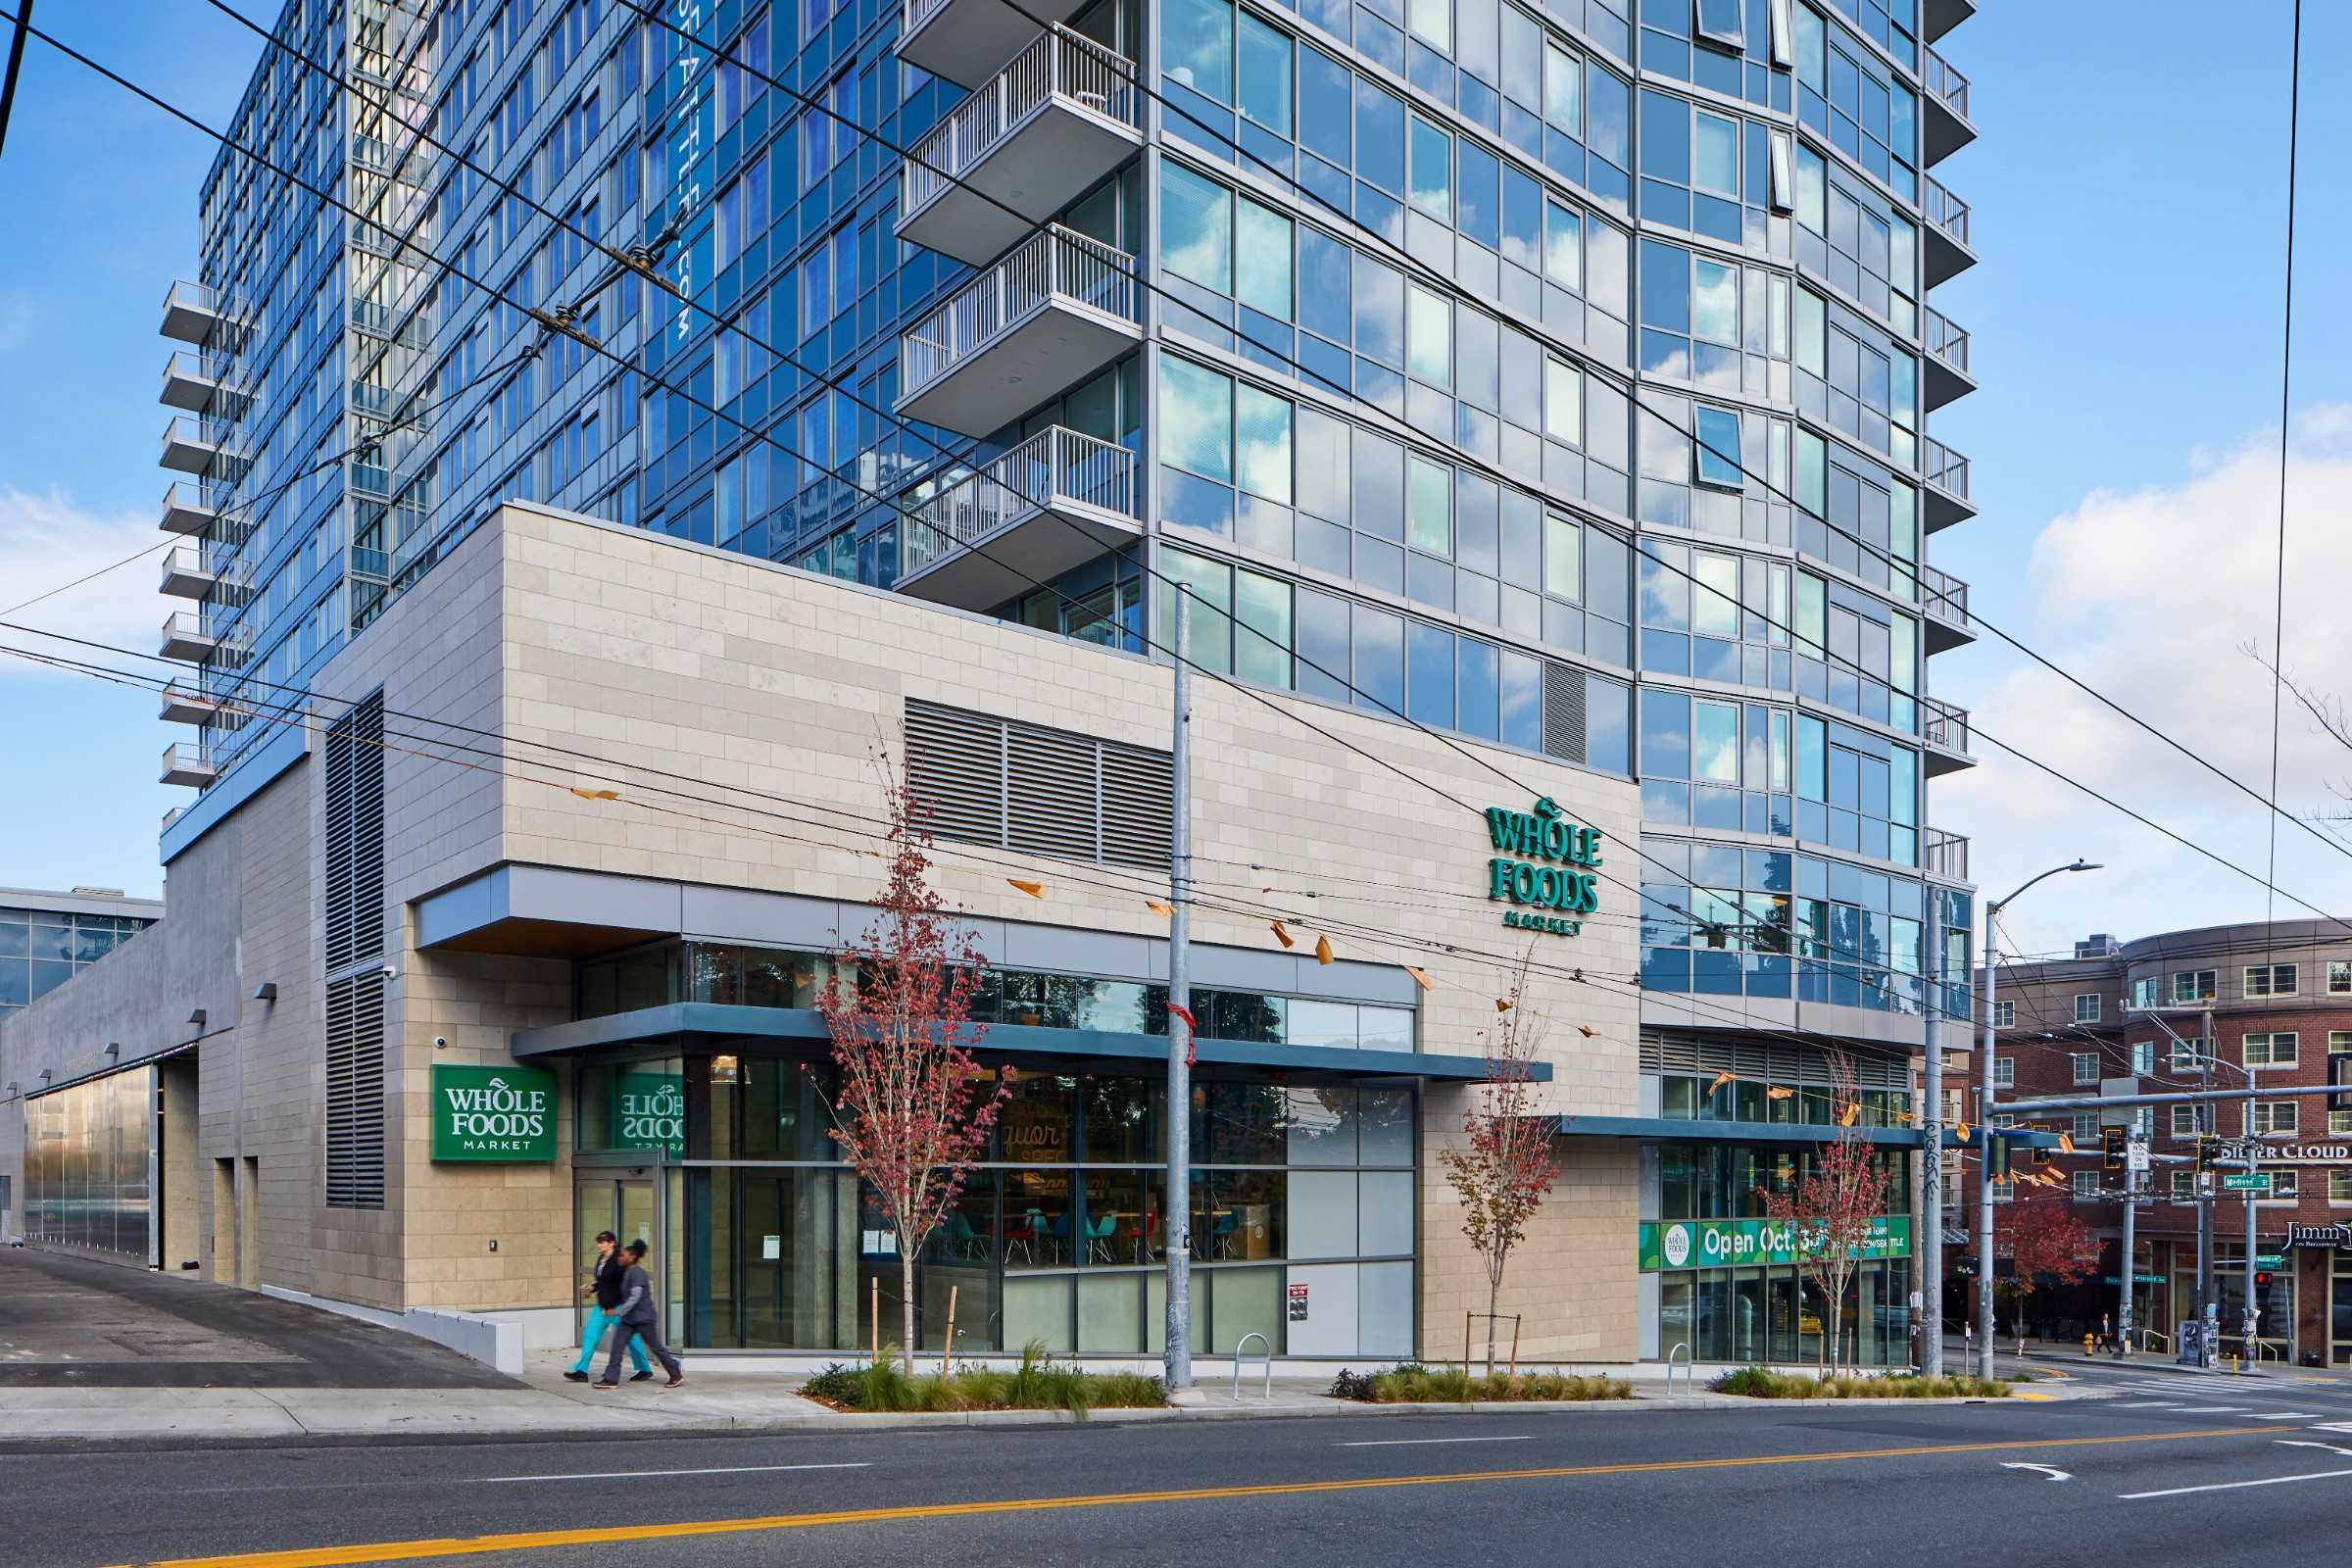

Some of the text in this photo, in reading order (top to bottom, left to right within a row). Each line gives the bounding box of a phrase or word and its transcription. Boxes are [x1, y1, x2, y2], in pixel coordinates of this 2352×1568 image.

[1486, 802, 1603, 866] WHOLE
[1489, 858, 1598, 912] FOODS
[1503, 910, 1583, 936] MARKET
[445, 1086, 546, 1112] WHOLE
[451, 1112, 543, 1137] FOODS
[464, 1141, 530, 1150] MARKET
[2221, 1145, 2349, 1159] SILER CLOUD
[2226, 1178, 2254, 1187] Madison
[1667, 1235, 1687, 1246] WHOLE
[1668, 1245, 1687, 1253] FOODS
[1704, 1228, 1754, 1260] Open
[1759, 1227, 1795, 1251] Oct.
